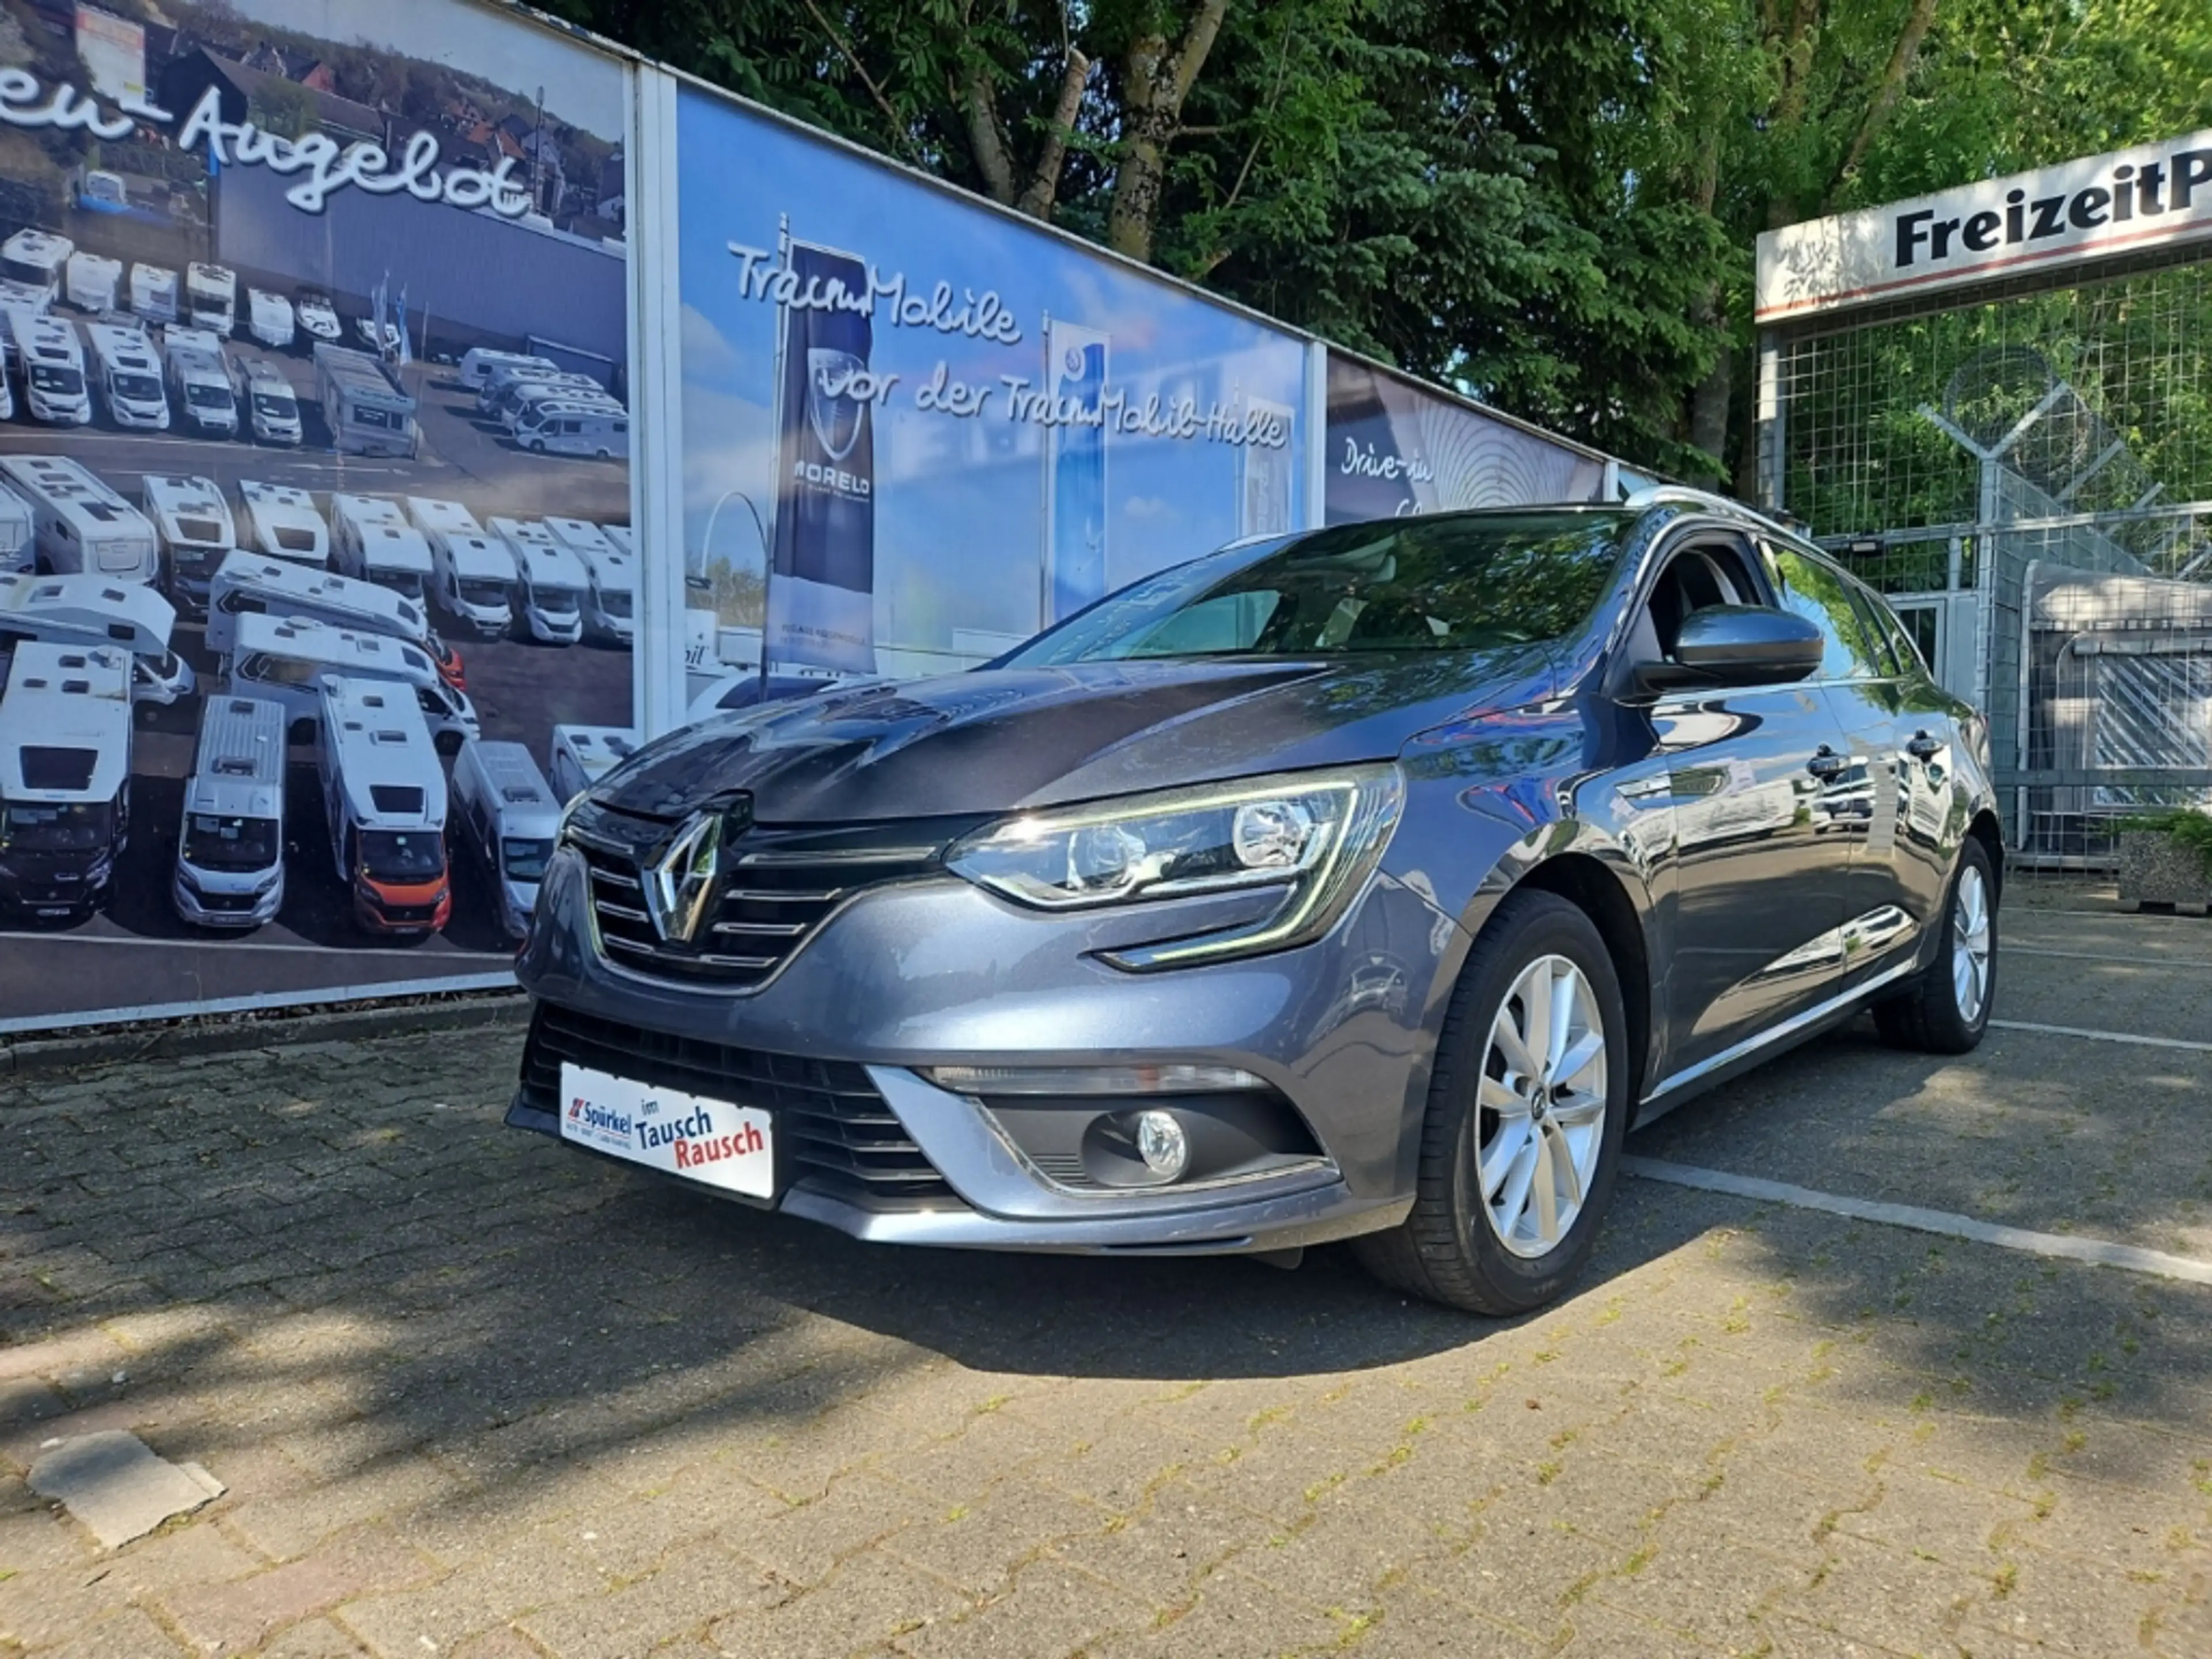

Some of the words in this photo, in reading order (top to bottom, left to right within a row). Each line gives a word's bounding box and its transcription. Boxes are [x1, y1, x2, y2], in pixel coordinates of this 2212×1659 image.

[1896, 150, 2212, 267] FreizeitP
[819, 366, 898, 405] vor
[915, 361, 991, 416] der
[1341, 437, 1434, 482] Drive-in
[585, 1101, 631, 1135] Spürkel
[635, 1105, 712, 1150] Tausch
[641, 1099, 660, 1116] im
[675, 1122, 763, 1169] Rausch
